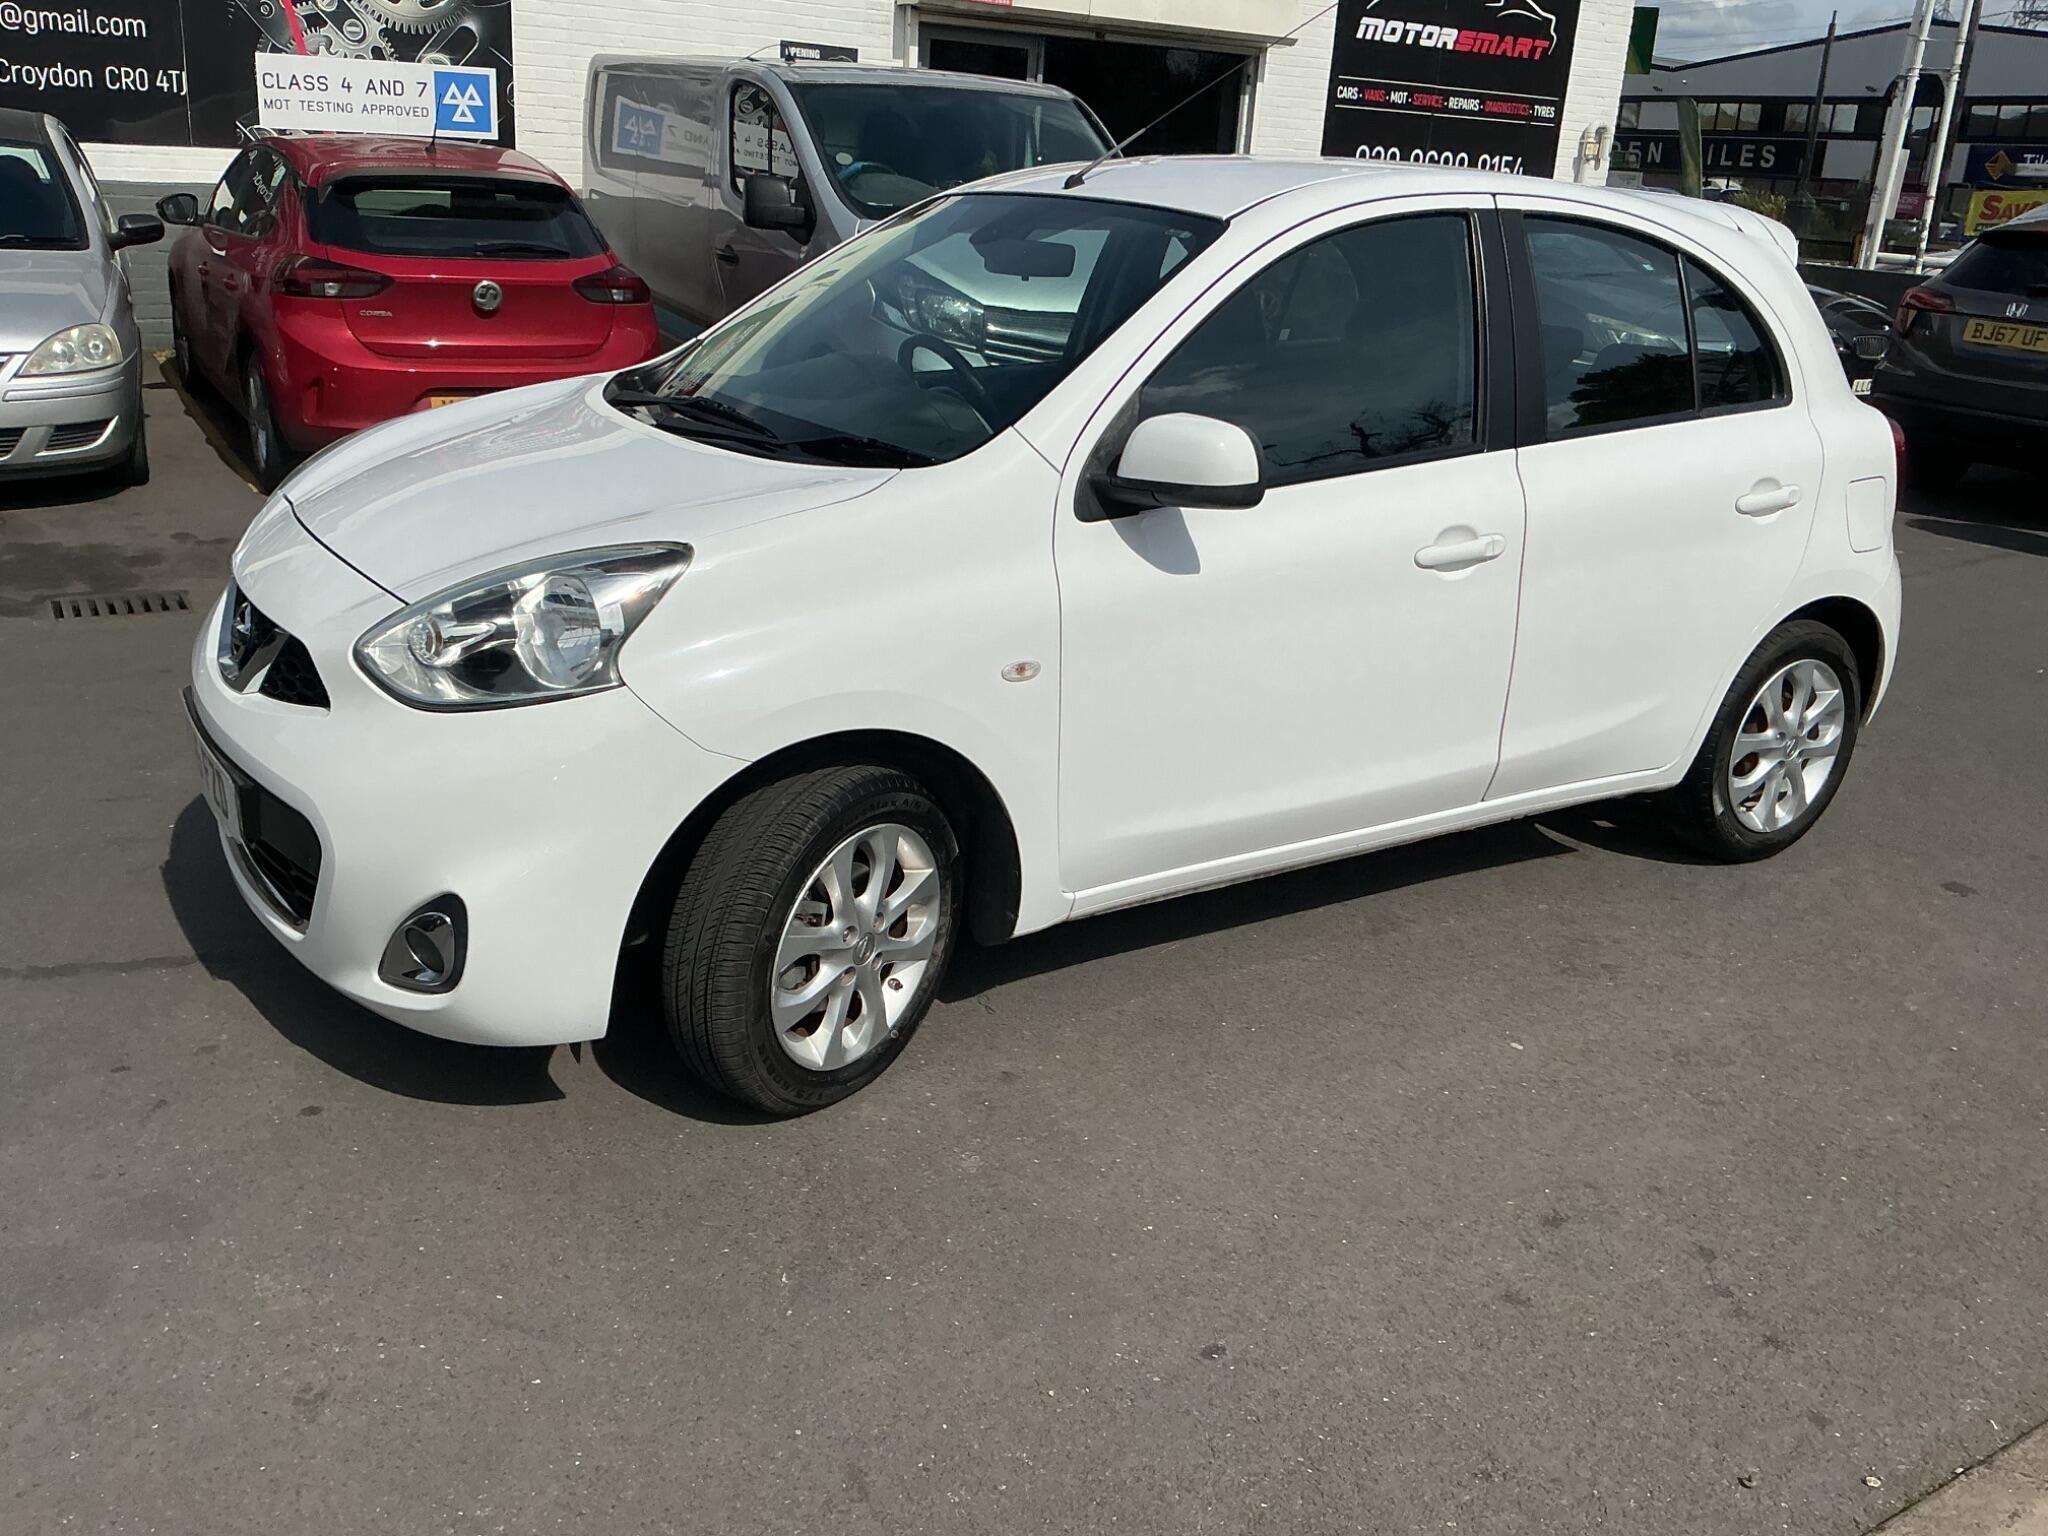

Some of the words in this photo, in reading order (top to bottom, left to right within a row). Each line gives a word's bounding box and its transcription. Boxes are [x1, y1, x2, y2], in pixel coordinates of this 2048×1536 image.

[0, 2, 147, 38] @gmail.com
[1356, 16, 1550, 61] MOTORSMART
[0, 58, 93, 91] Croydon
[262, 72, 329, 92] CLASS
[341, 77, 352, 93] 4
[365, 79, 405, 97] AND
[416, 81, 428, 98] 7
[263, 99, 290, 111] MOT
[300, 100, 354, 114] TESTING
[361, 105, 430, 118] APPROVED
[1337, 85, 1359, 100] CARS
[1364, 89, 1386, 102] VANS
[1390, 91, 1408, 104] MOT
[1413, 93, 1444, 108] SERVICE
[1448, 97, 1480, 111] REPAIRS
[1534, 105, 1556, 118] TYRES
[1707, 143, 1776, 168] ILES
[1970, 322, 2019, 345] BJ67
